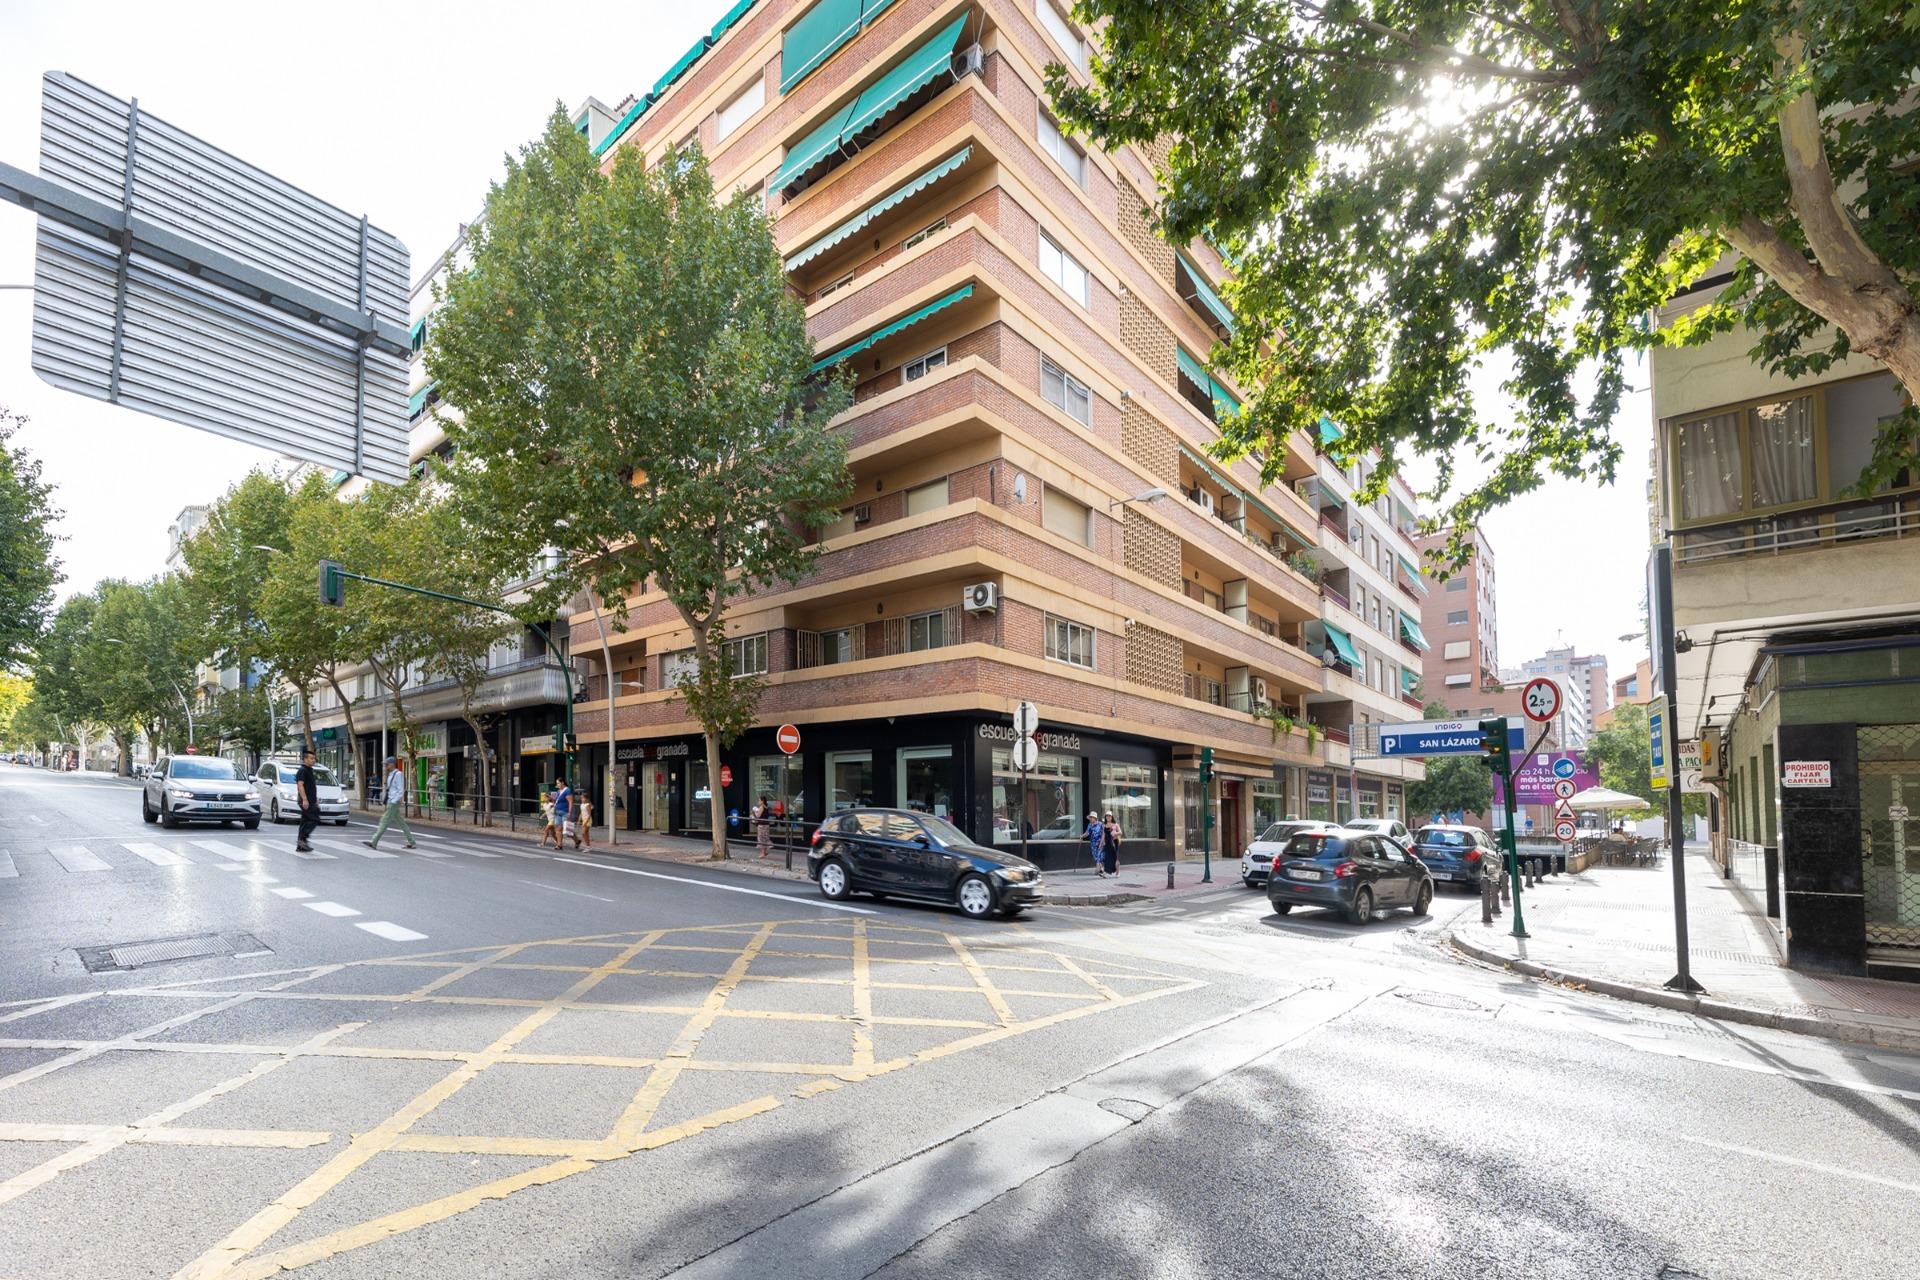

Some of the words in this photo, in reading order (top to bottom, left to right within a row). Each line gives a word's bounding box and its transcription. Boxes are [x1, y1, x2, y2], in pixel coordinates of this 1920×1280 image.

[1384, 738, 1396, 753] P
[1419, 739, 1439, 748] SAN
[1441, 737, 1480, 747] LÁZARO
[1786, 763, 1829, 771] PROHIBIDO
